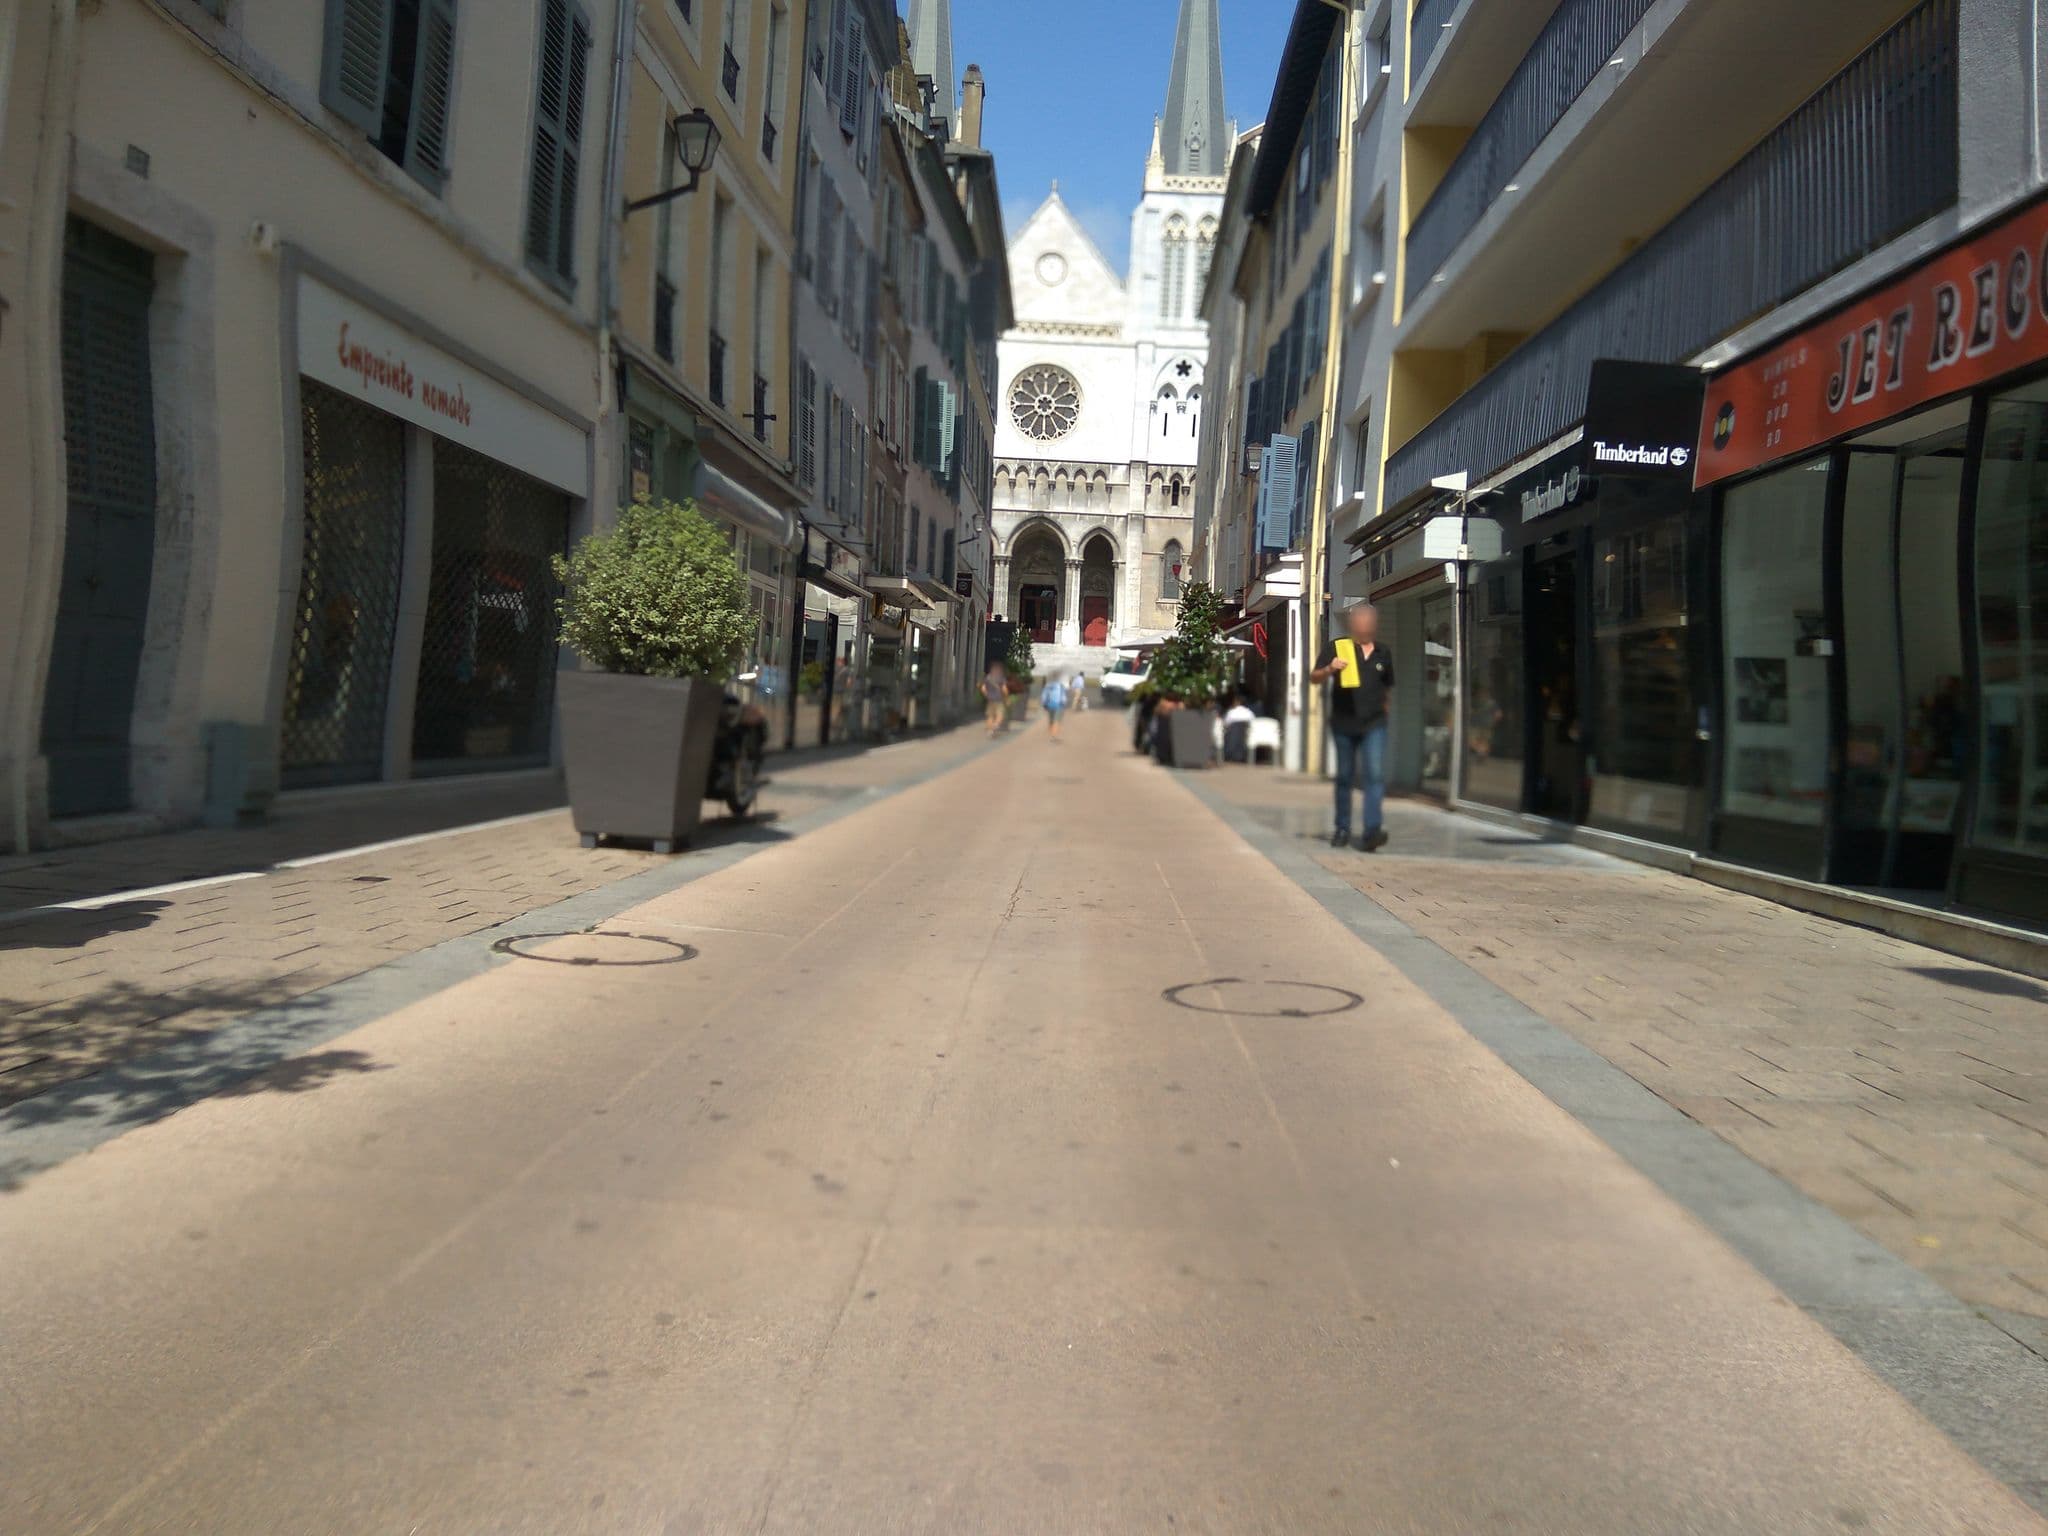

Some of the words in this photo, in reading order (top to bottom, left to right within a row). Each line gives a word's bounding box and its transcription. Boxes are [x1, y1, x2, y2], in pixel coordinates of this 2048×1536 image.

[1826, 304, 1913, 413] JET
[337, 320, 414, 399] Empreinte
[422, 381, 471, 427] nomade
[1772, 380, 1788, 399] CD
[1766, 402, 1789, 425] DVD
[1766, 429, 1782, 448] BD
[1594, 441, 1668, 465] Timberland
